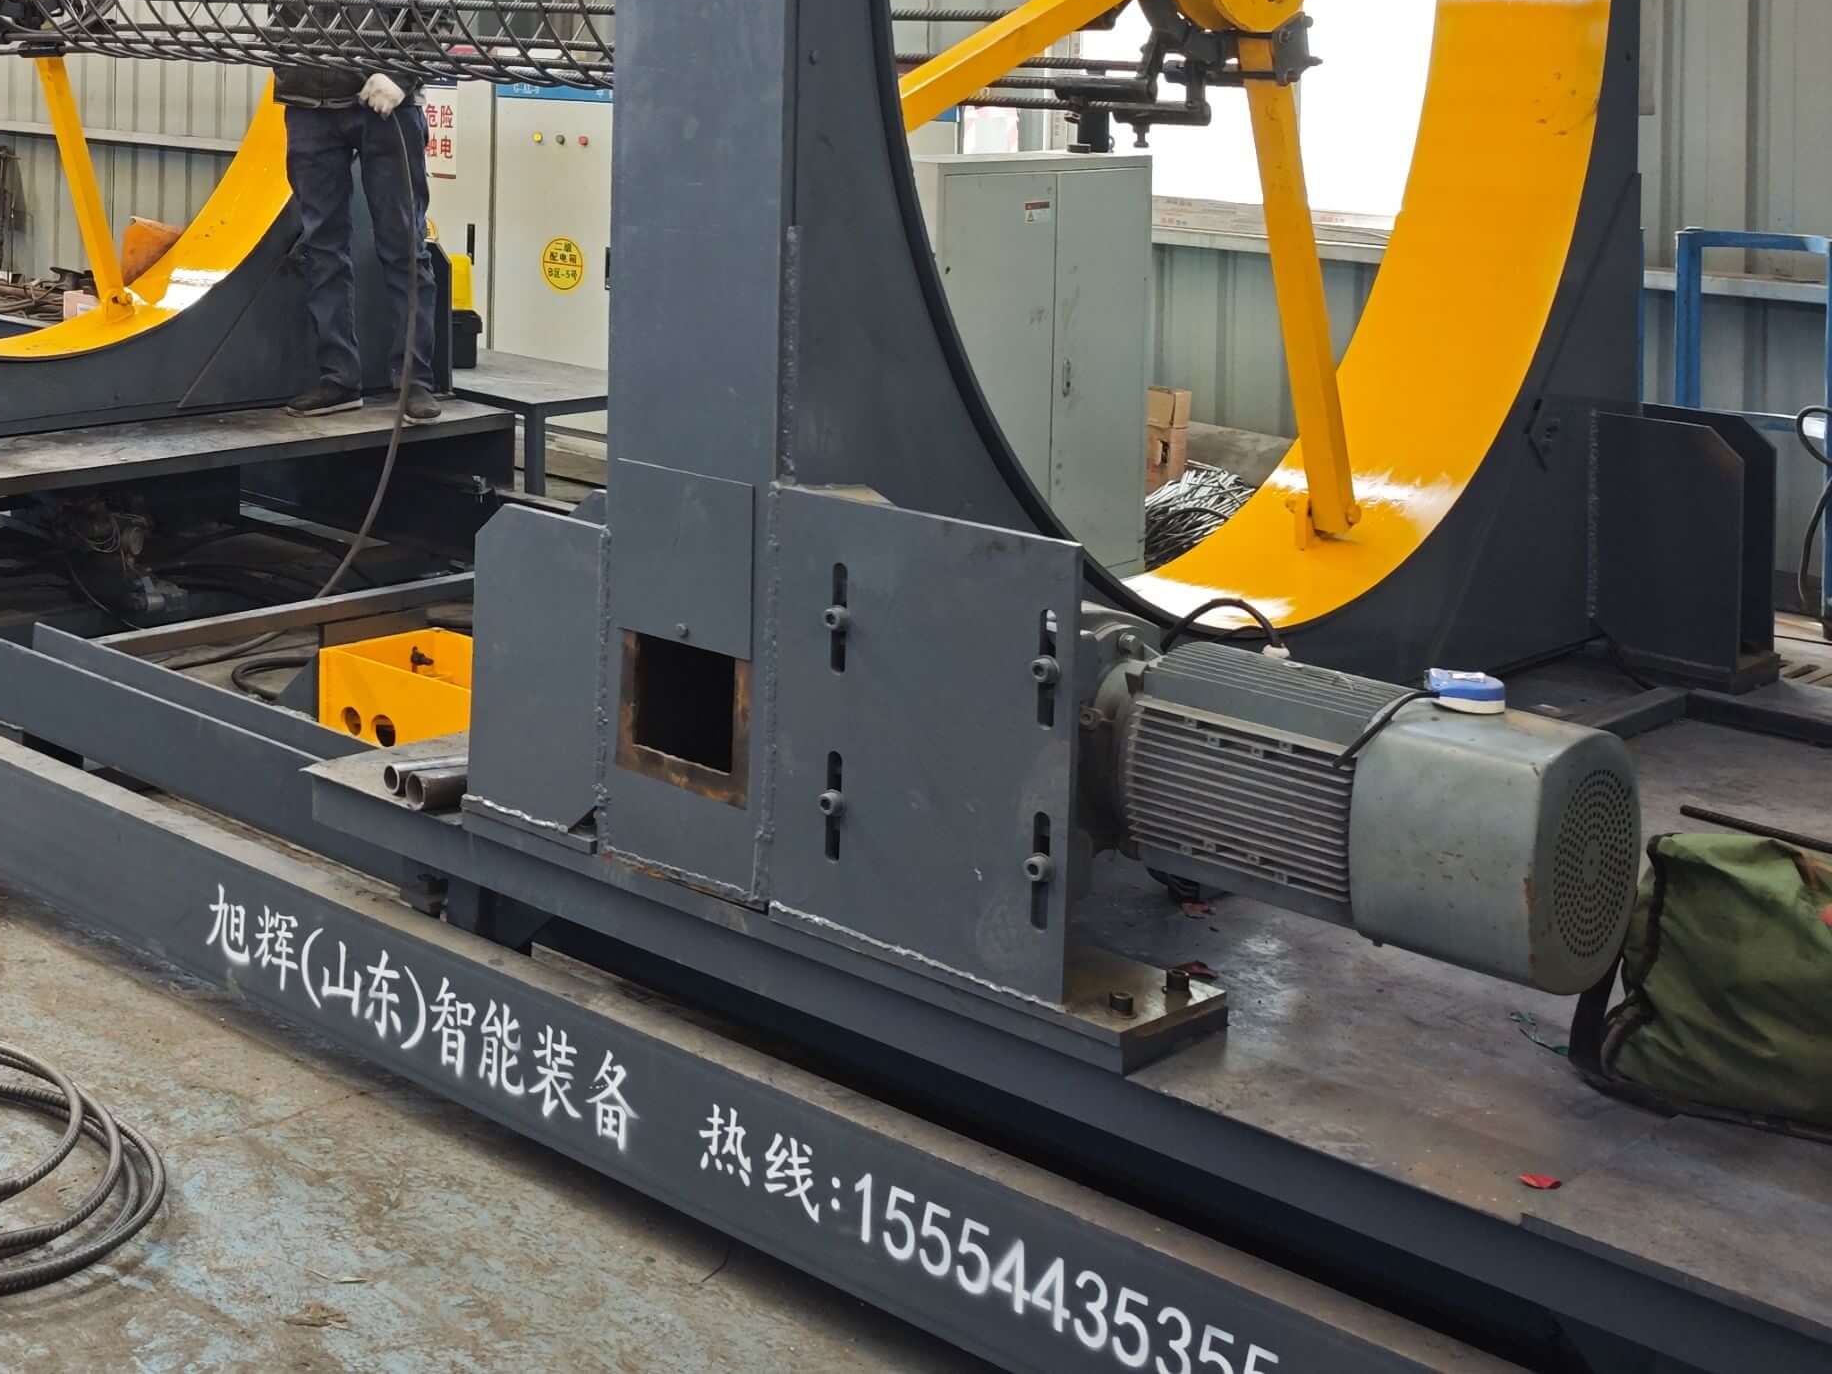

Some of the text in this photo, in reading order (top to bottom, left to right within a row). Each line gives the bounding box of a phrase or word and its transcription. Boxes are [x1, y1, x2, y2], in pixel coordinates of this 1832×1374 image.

[425, 103, 454, 129] 危险
[206, 882, 640, 1152] 旭辉(山东)智能装备
